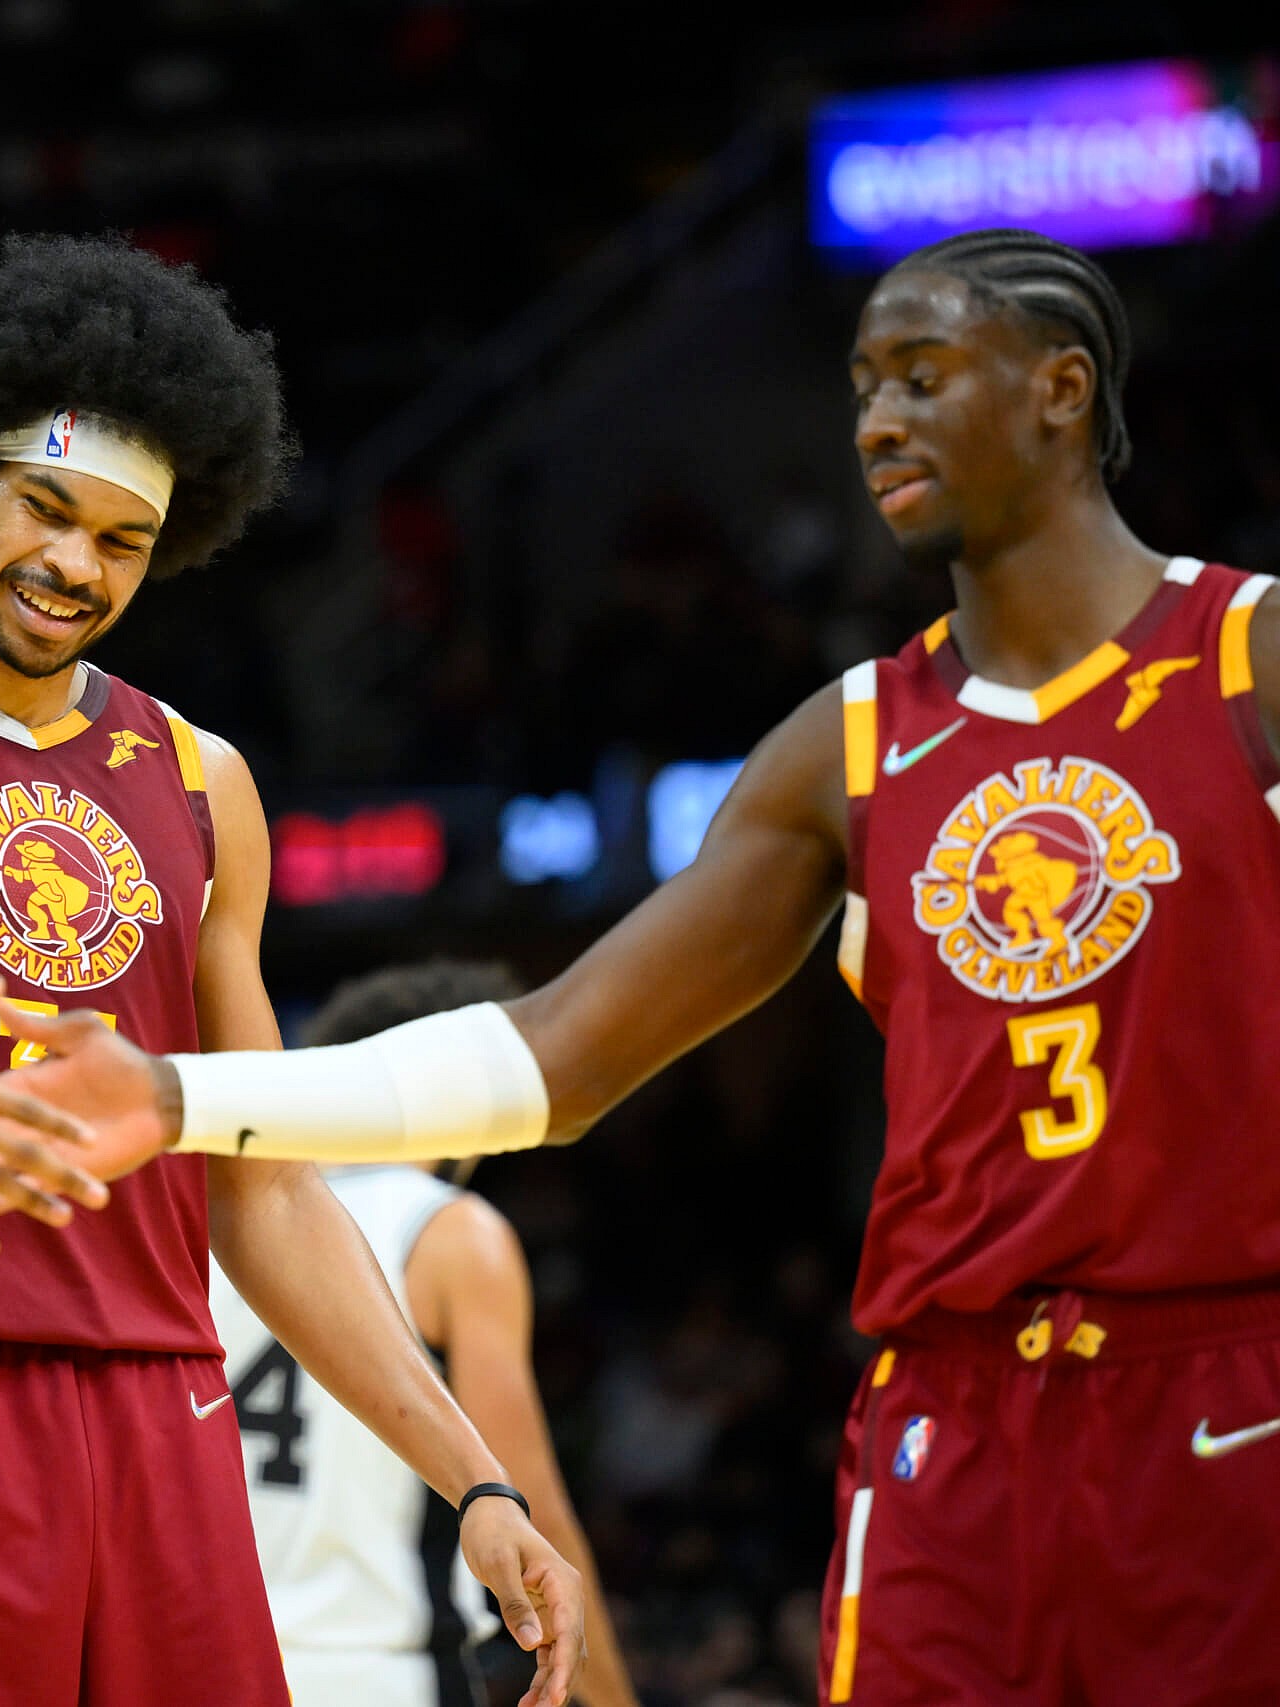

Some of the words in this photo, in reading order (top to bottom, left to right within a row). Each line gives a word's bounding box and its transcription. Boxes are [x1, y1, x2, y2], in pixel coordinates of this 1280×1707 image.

[911, 756, 1182, 932] CAVALIERS
[940, 887, 1152, 999] CLEVELAND
[1006, 1002, 1108, 1161] 3
